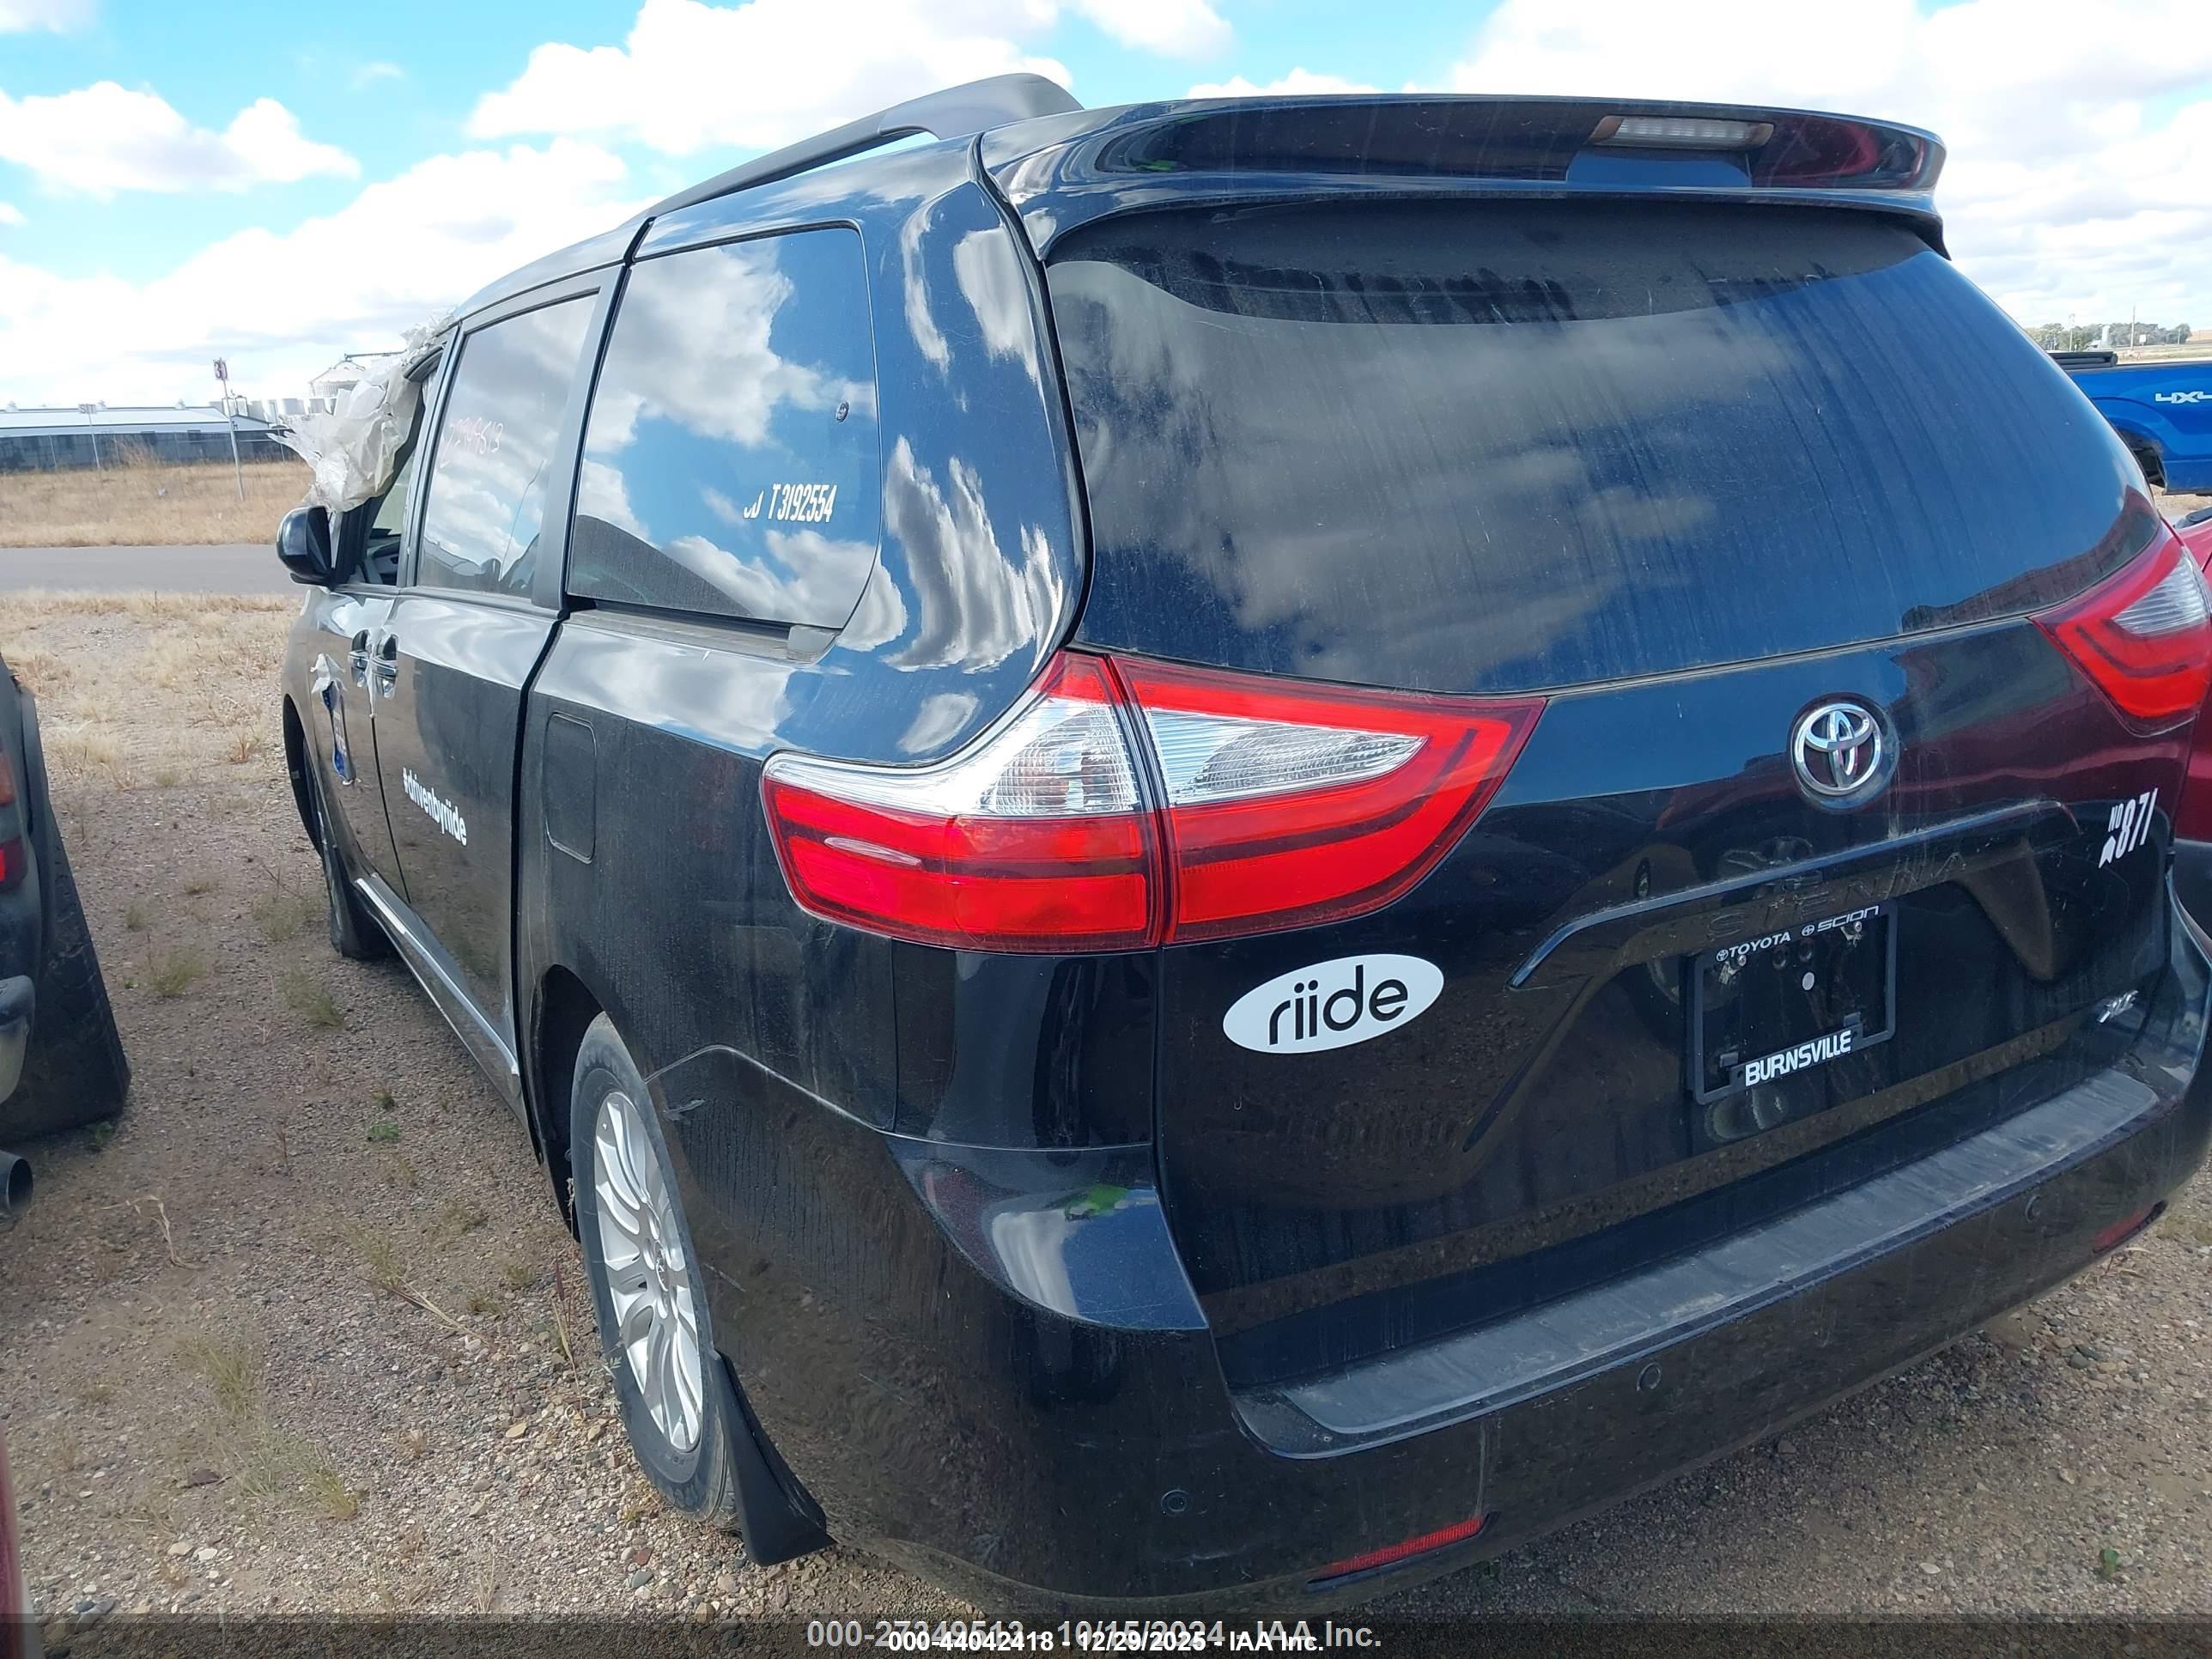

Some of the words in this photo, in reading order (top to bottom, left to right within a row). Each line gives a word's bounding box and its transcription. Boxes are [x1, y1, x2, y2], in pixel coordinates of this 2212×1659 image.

[2115, 787, 2159, 860] 871
[1729, 932, 1790, 958] TOYOTA
[1269, 964, 1408, 1046] riide
[1745, 1030, 1851, 1087] BURNSVILLE
